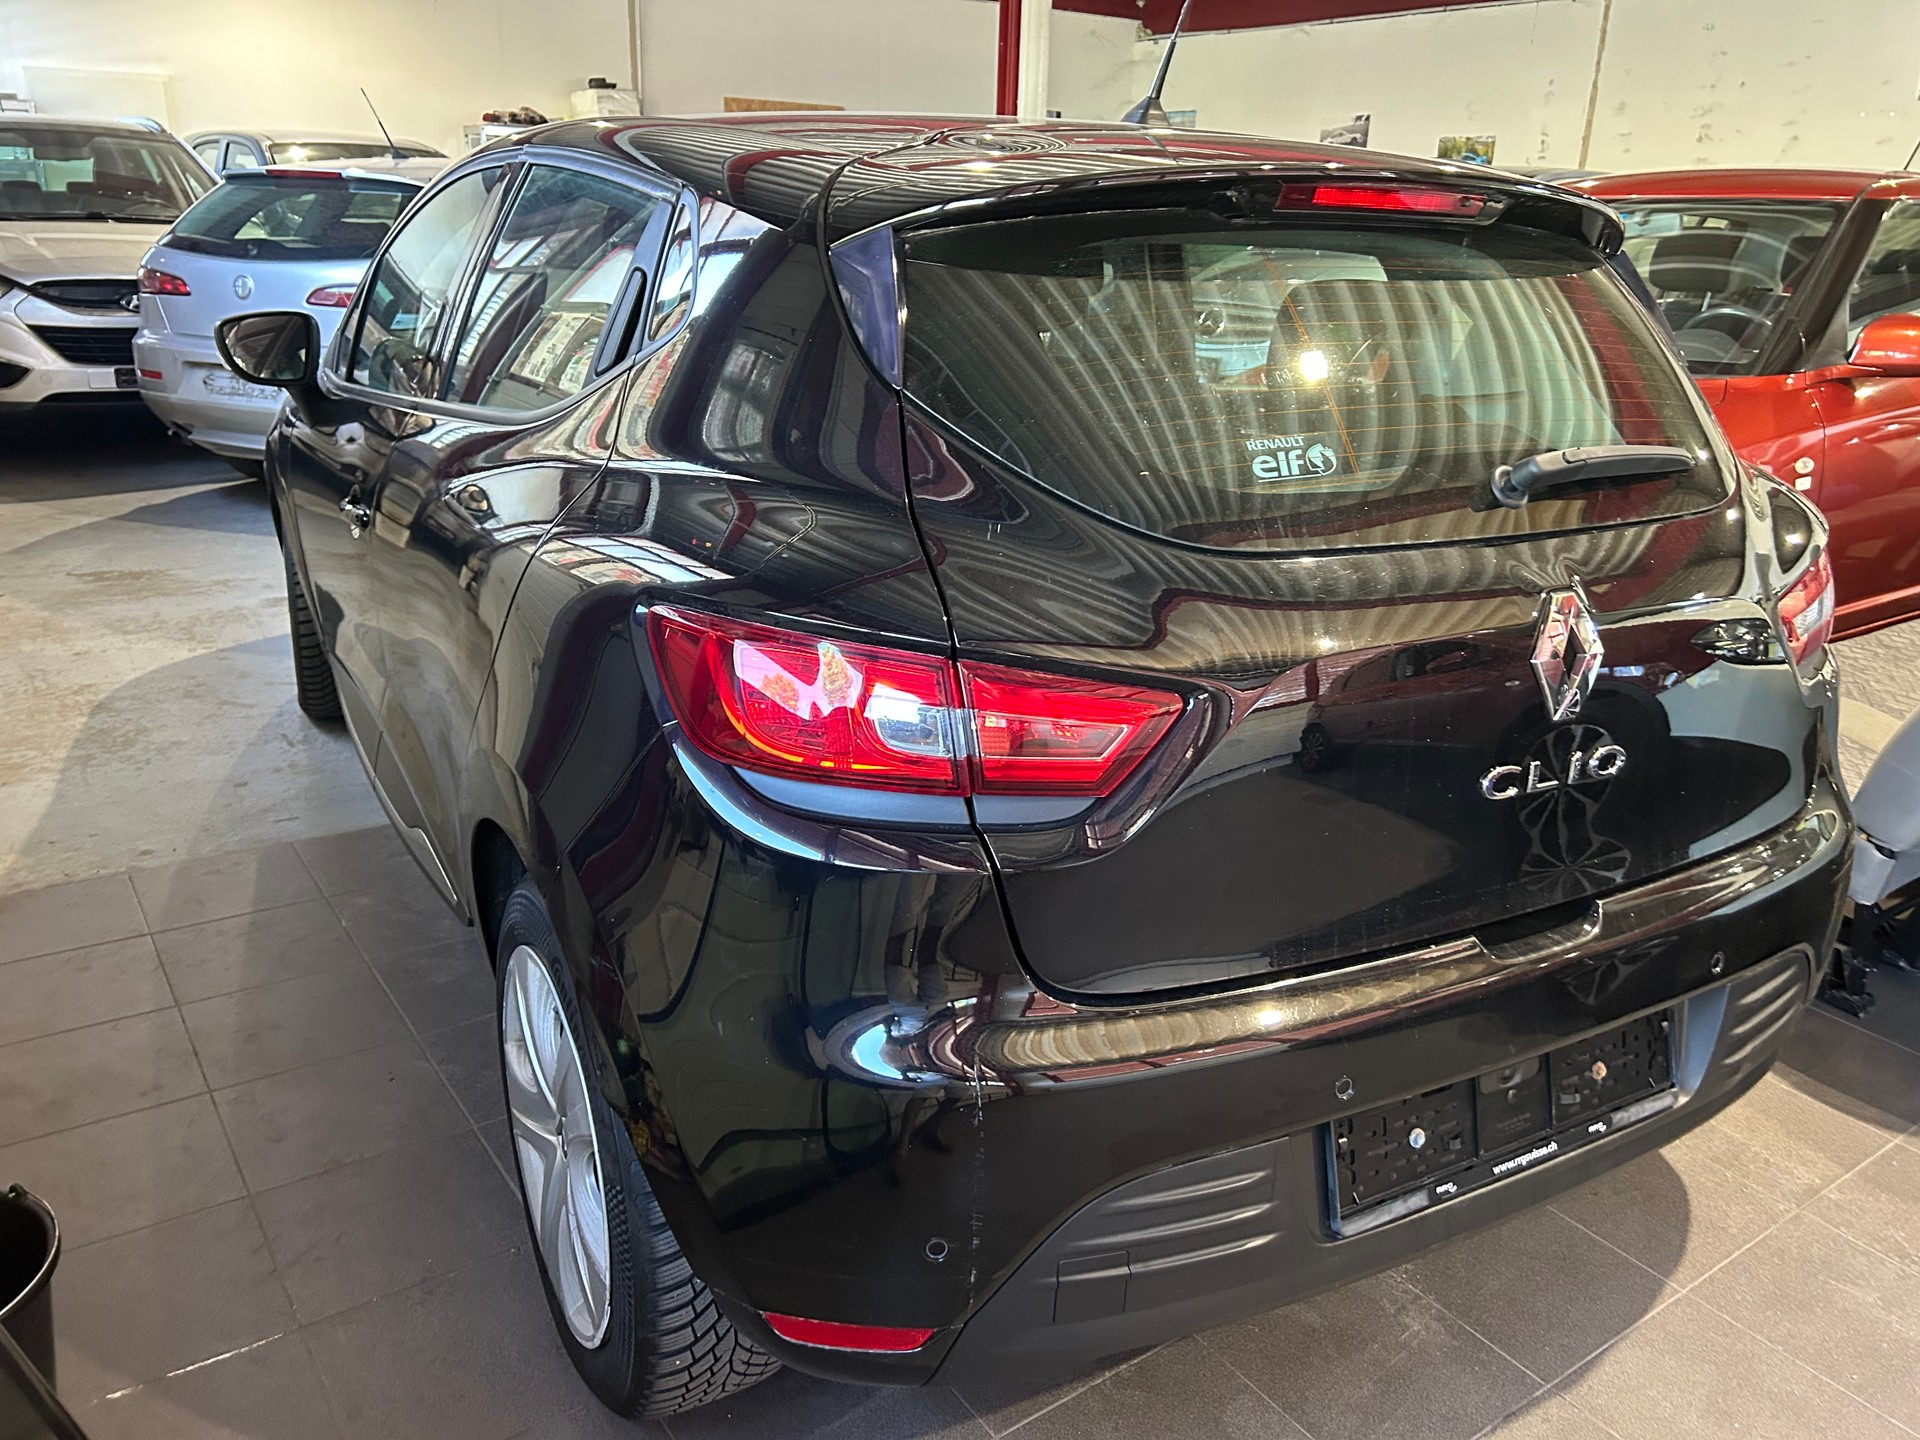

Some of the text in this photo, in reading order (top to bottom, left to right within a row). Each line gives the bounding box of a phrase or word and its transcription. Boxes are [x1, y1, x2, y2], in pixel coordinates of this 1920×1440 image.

[1245, 436, 1304, 451] RENAULT
[1252, 449, 1304, 478] elf
[1479, 745, 1627, 800] CLIO
